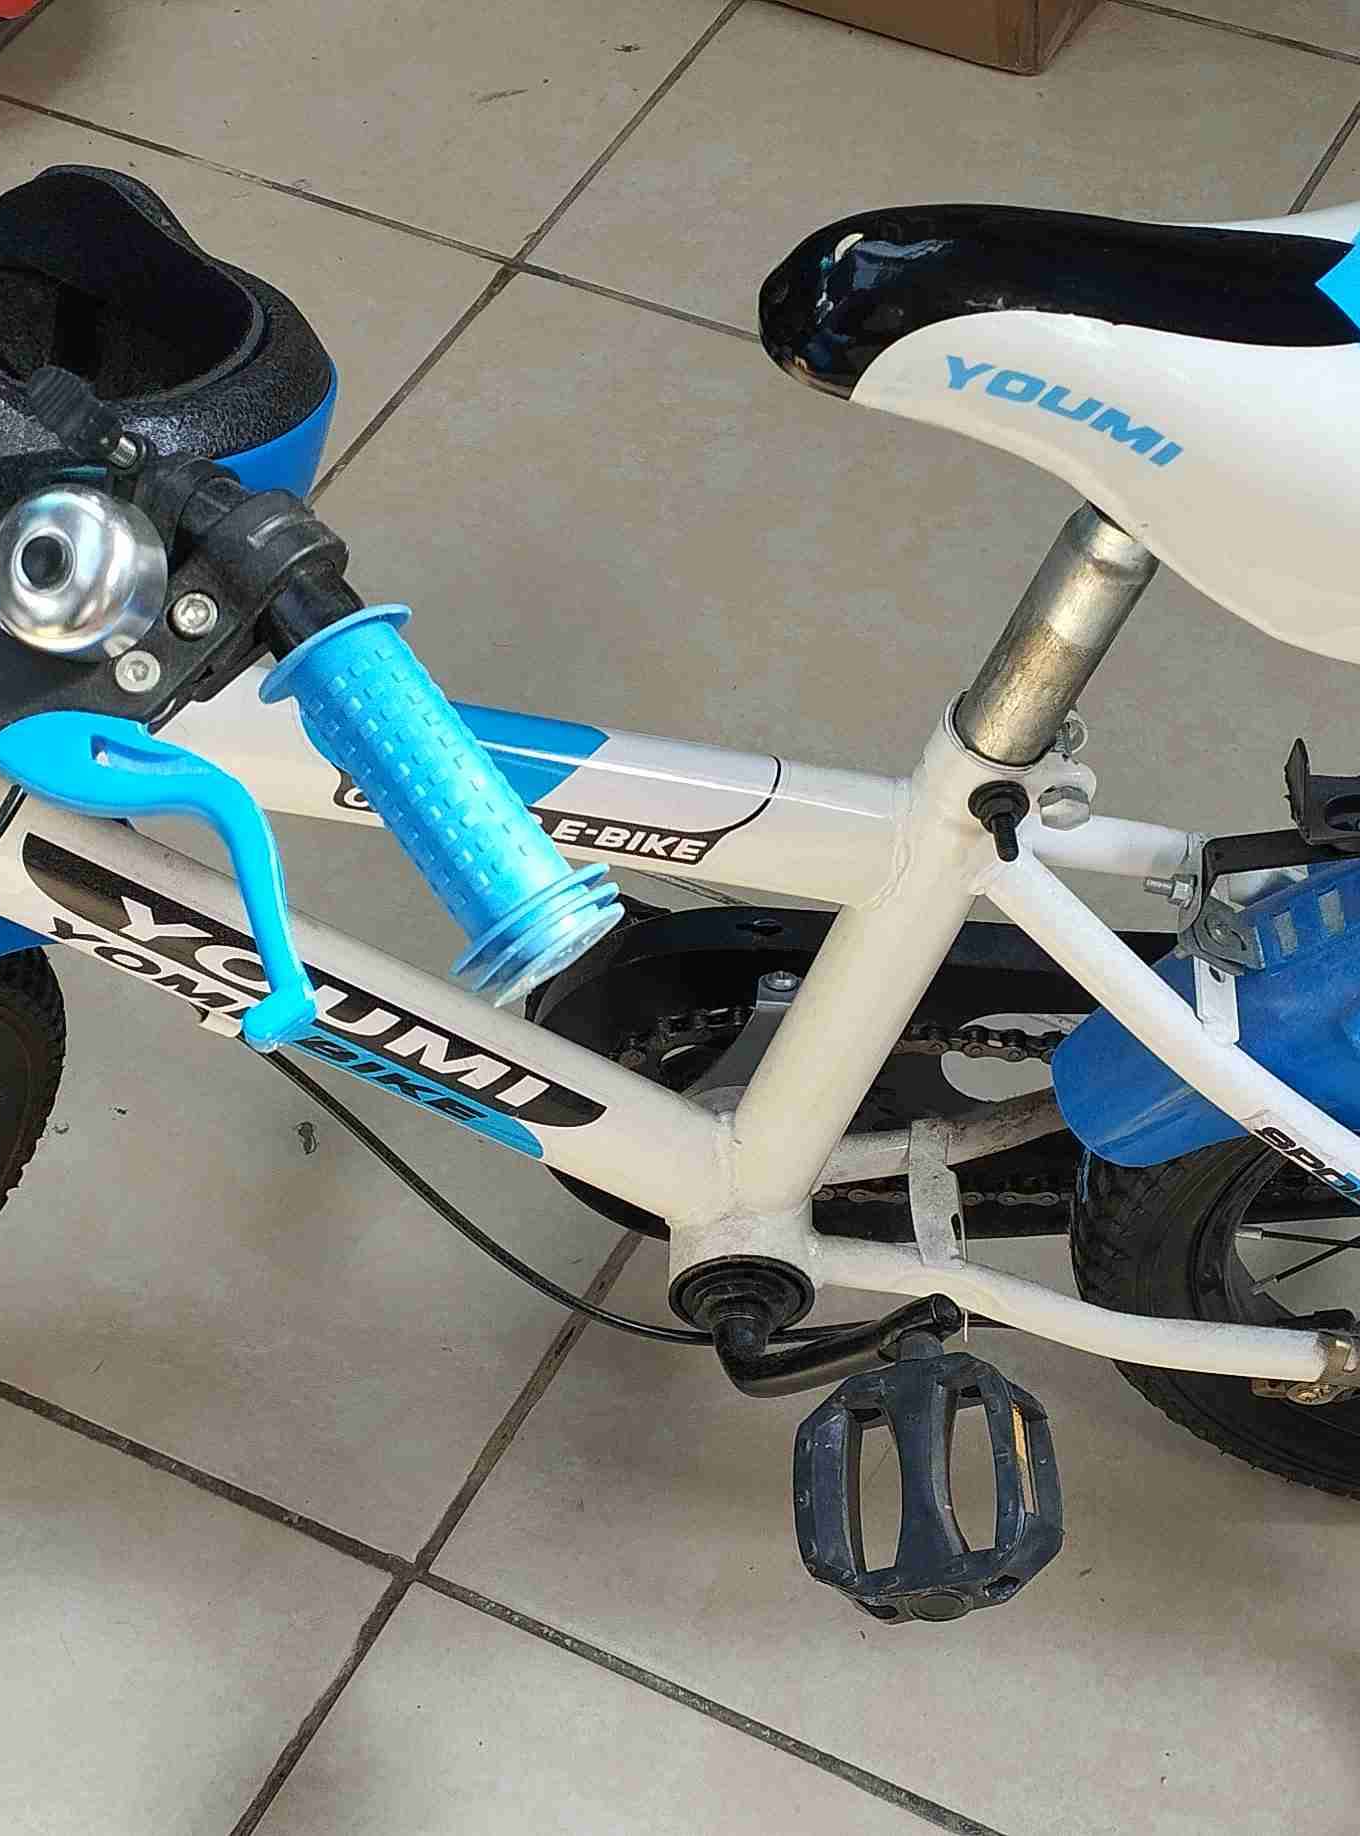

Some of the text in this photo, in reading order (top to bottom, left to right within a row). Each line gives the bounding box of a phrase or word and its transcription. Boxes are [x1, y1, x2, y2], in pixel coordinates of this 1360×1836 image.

[946, 355, 1184, 466] YOUMI
[553, 818, 709, 862] E-BIKE
[118, 895, 551, 1108] YOUMI
[292, 1034, 490, 1123] BIKE
